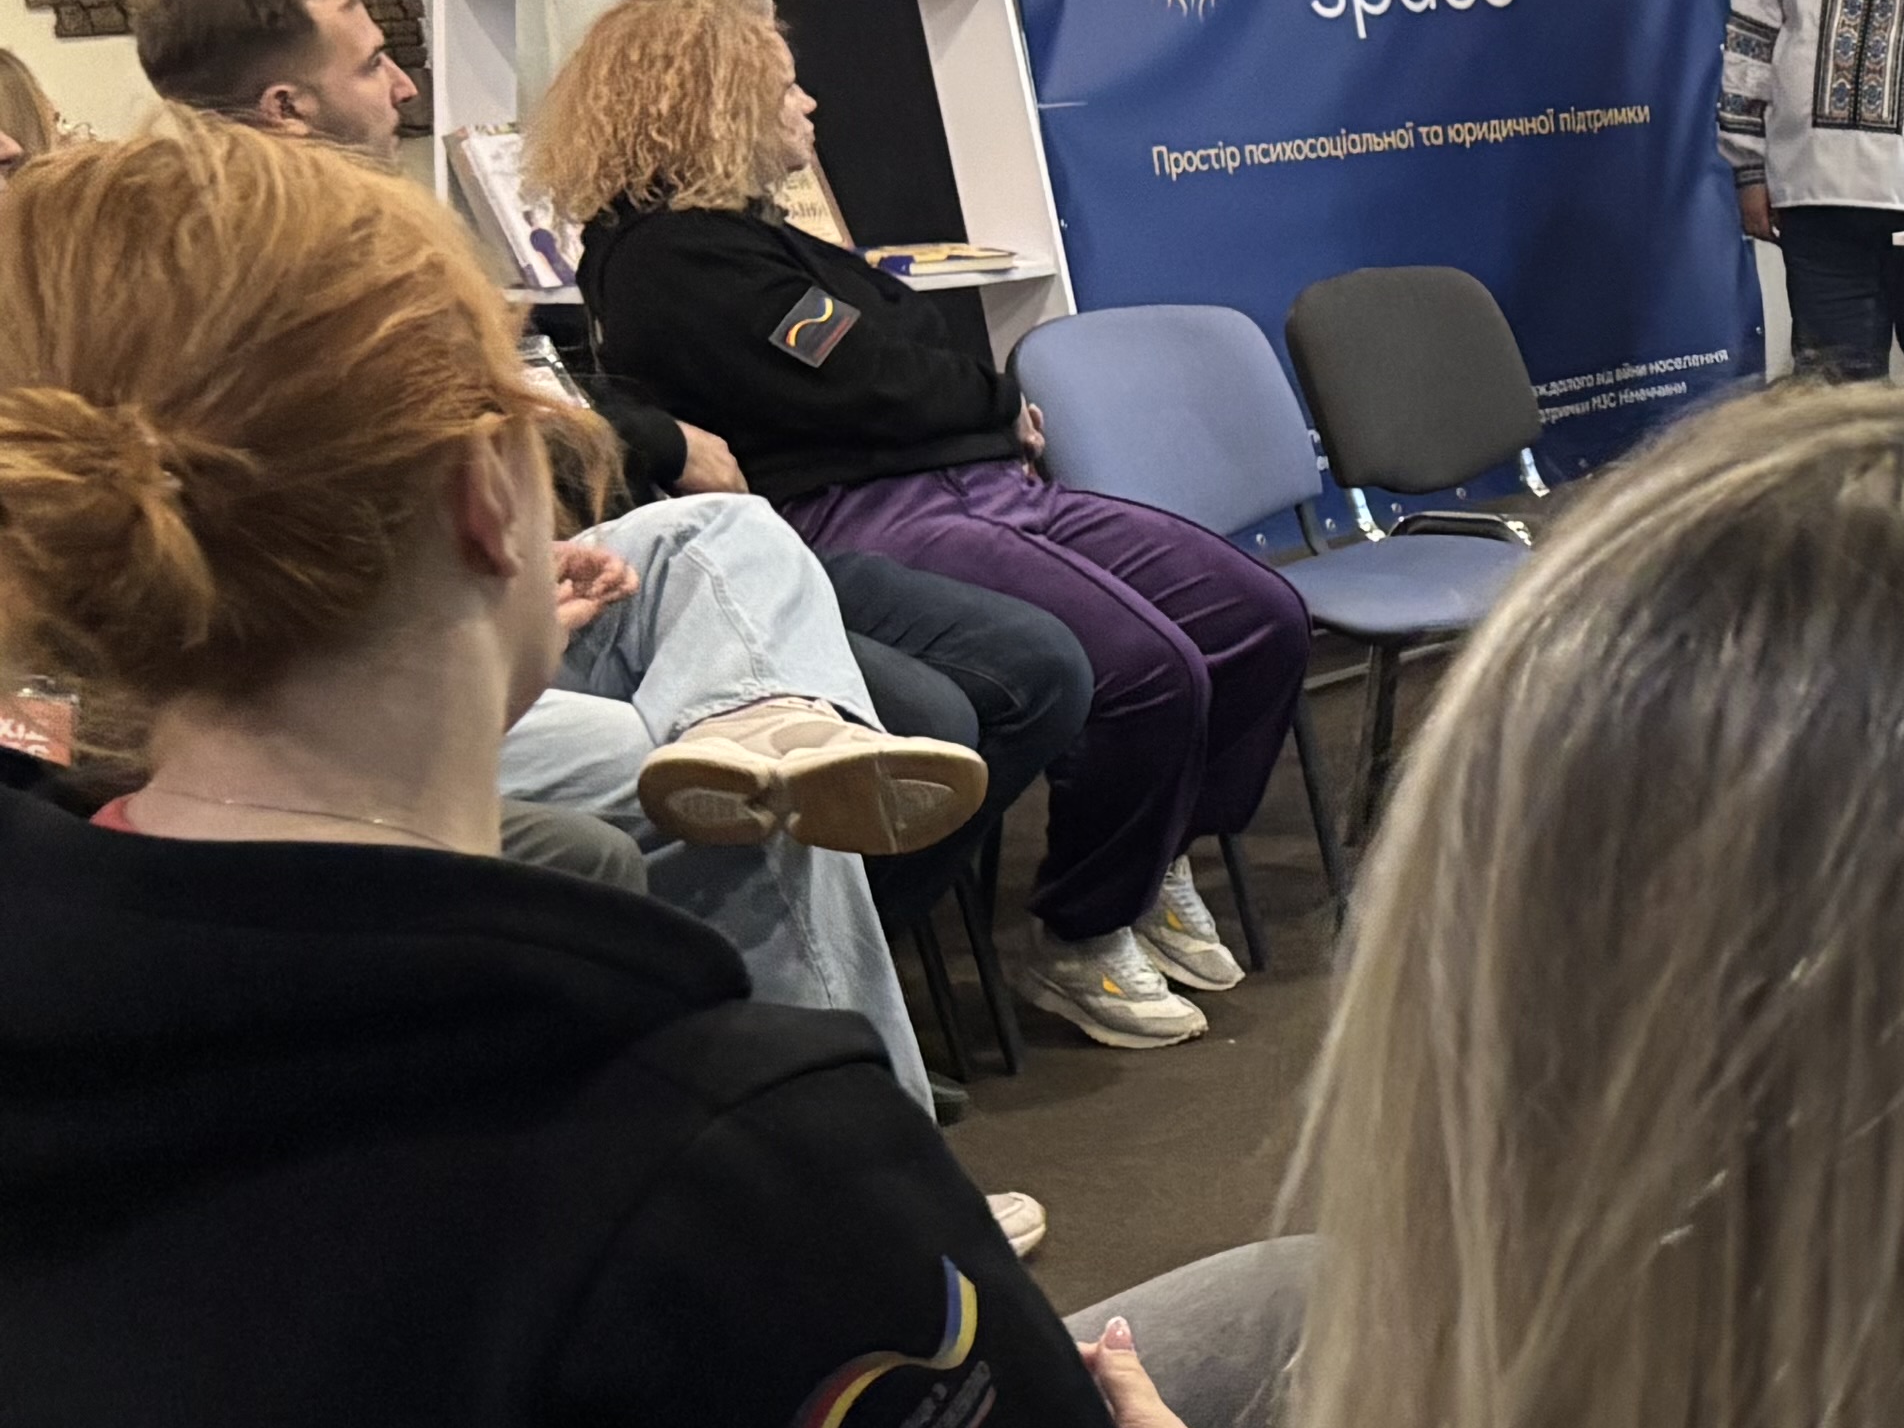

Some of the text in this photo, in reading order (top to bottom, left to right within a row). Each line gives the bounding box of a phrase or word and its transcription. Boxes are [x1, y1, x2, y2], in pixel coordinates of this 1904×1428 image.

[1151, 104, 1651, 182] Простір психосоціальної та юридичної підтримки
[1649, 348, 1730, 375] населення
